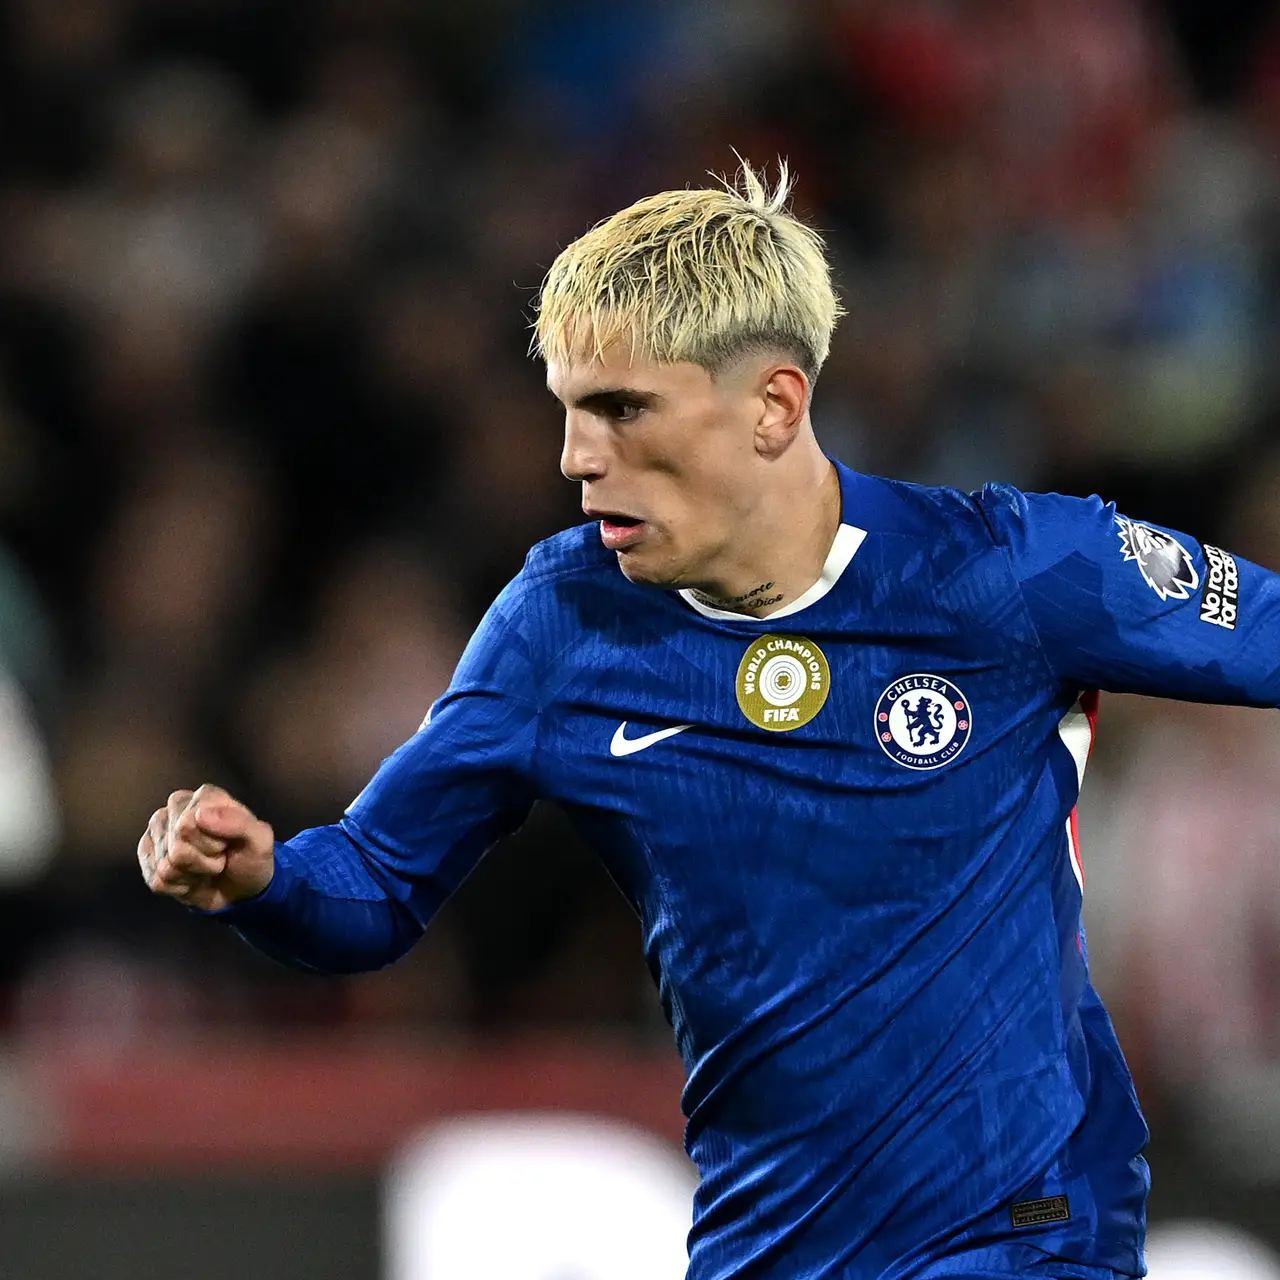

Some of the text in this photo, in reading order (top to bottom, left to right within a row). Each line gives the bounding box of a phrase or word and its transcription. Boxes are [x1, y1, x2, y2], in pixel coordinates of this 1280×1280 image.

[1200, 592, 1221, 624] No
[1217, 597, 1237, 630] for
[744, 639, 821, 695] WORLD CHAMPIONS
[887, 677, 948, 701] CHELSEA
[763, 707, 800, 723] FIFA
[896, 741, 960, 765] FOOTBALL CLUB
